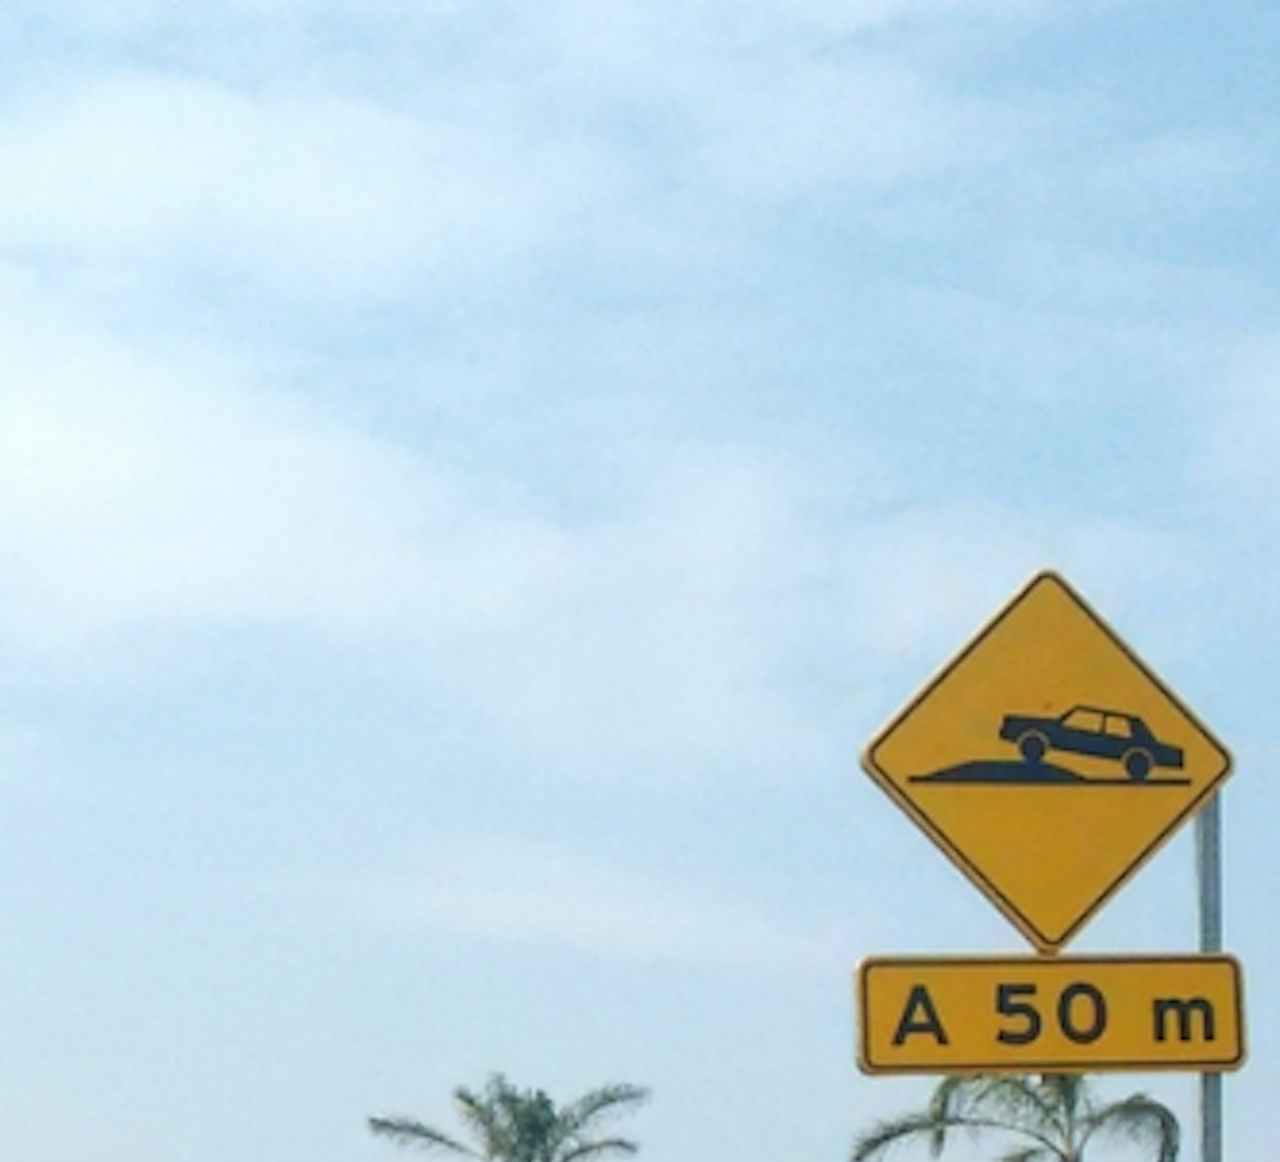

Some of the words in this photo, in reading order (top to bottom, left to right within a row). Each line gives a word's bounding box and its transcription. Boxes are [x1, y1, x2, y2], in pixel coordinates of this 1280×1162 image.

[891, 984, 949, 1046] A
[995, 982, 1108, 1046] 50
[1153, 996, 1216, 1042] m
